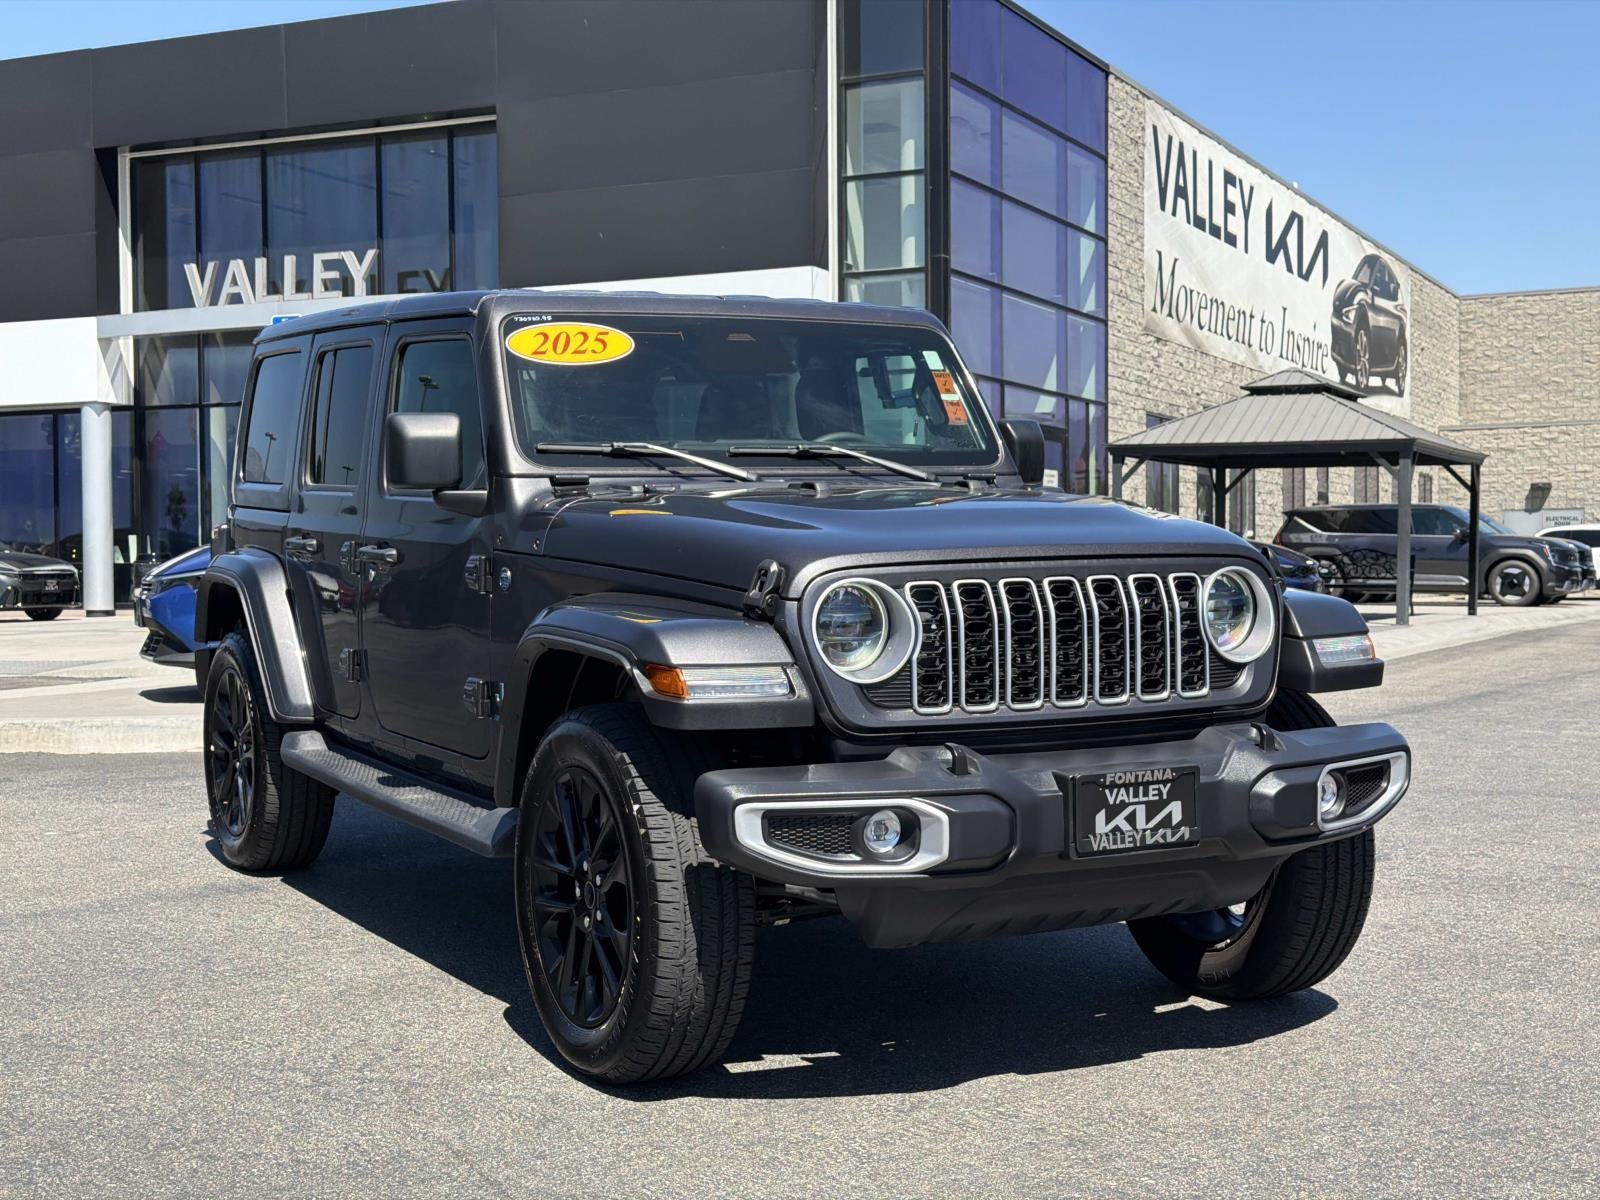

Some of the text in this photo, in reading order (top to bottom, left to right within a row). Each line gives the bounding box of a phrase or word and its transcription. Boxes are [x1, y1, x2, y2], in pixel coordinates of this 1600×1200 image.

[1152, 124, 1329, 289] VALLEY KIA
[184, 248, 379, 308] VALLEY
[1151, 249, 1329, 375] Movement to Inspire
[531, 331, 610, 356] 2025
[1106, 768, 1172, 784] FONTANA
[1105, 783, 1171, 805] VALLEY
[1095, 800, 1183, 836] KIA
[1088, 826, 1190, 852] VALLEY KIA
